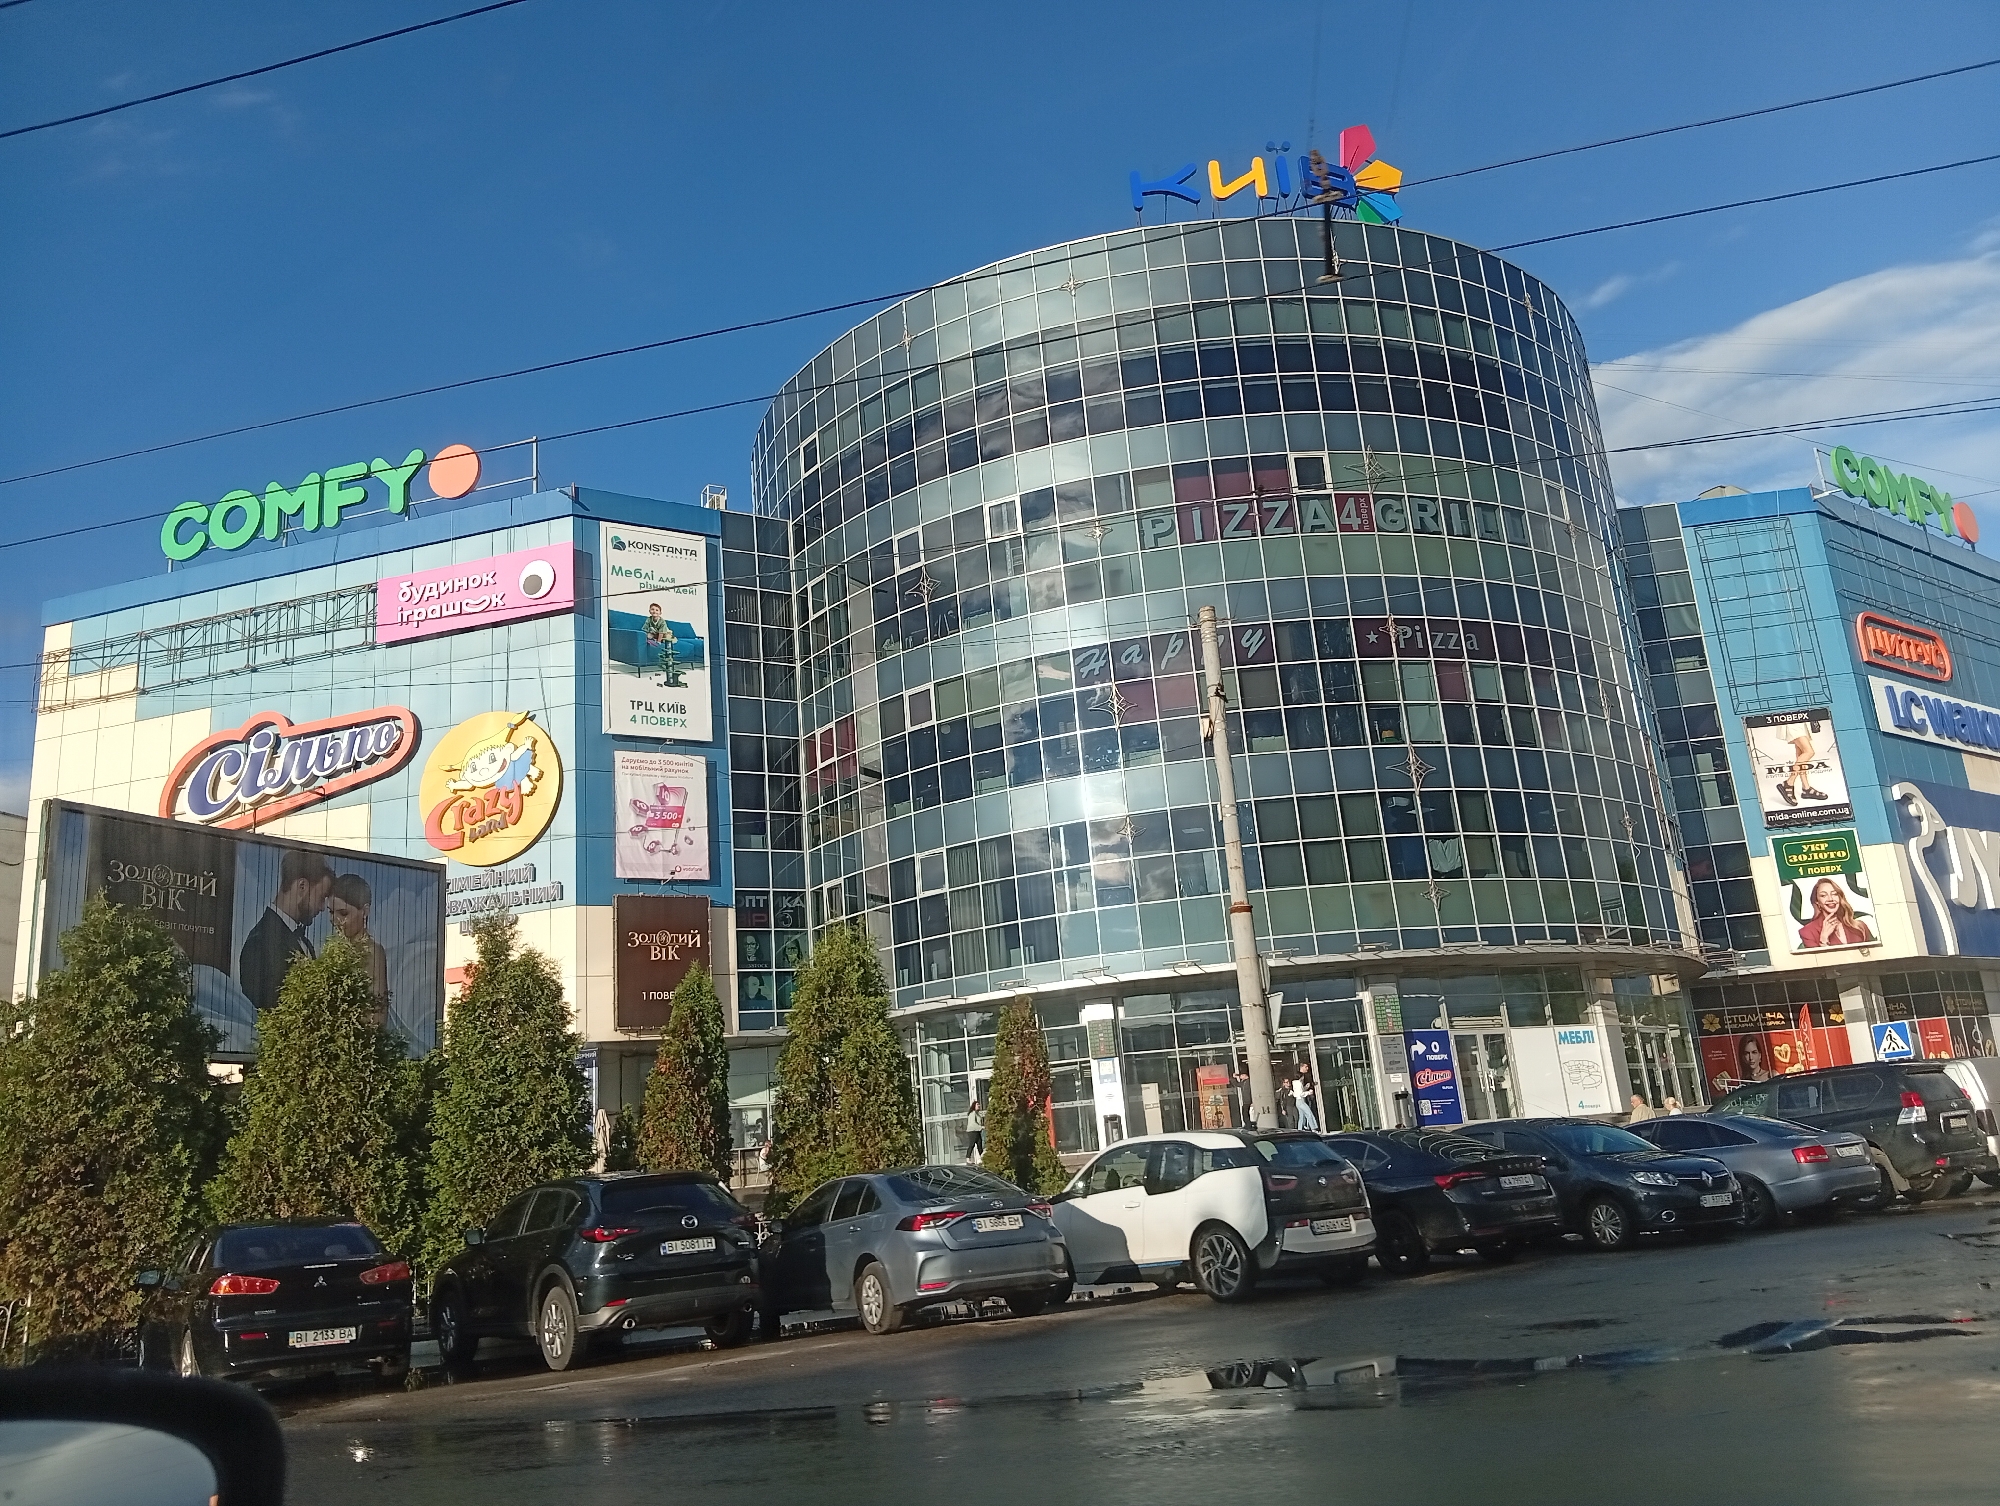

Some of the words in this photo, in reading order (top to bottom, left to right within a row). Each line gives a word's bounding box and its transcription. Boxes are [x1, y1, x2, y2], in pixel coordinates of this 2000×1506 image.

[1830, 445, 1953, 537] COMFY
[160, 448, 427, 561] COMFY
[1340, 497, 1361, 530] 4
[1141, 499, 1335, 549] PIZZA
[628, 540, 697, 557] KONSTANTA
[611, 565, 654, 580] Меблі
[397, 570, 497, 605] будинок
[1075, 628, 1266, 679] Hapy
[630, 700, 654, 713] ТРЦ
[658, 701, 687, 714] КИЇВ
[630, 714, 637, 724] 4
[641, 715, 687, 728] ПОВЕРХ
[1766, 716, 1772, 724] 3
[1773, 712, 1809, 723] ПОВЕРХ
[1765, 761, 1830, 775] MIDA
[186, 730, 400, 822] Сільпо
[425, 779, 524, 851] Crazy
[1767, 807, 1850, 822] mida-online.com.ua
[1802, 842, 1828, 852] УКР
[1788, 851, 1847, 863] ЗОЛОТО
[1798, 866, 1804, 875] 1
[1808, 865, 1843, 874] ПОВЕРХ
[642, 991, 647, 1000] 1
[649, 991, 676, 1000] ПОВЕ
[1558, 1030, 1595, 1045] МЕБЛІ
[1431, 1041, 1440, 1053] 0
[1578, 1100, 1584, 1109] 4
[296, 1332, 308, 1343] BI
[313, 1330, 335, 1341] 2133
[340, 1328, 353, 1339] BA
